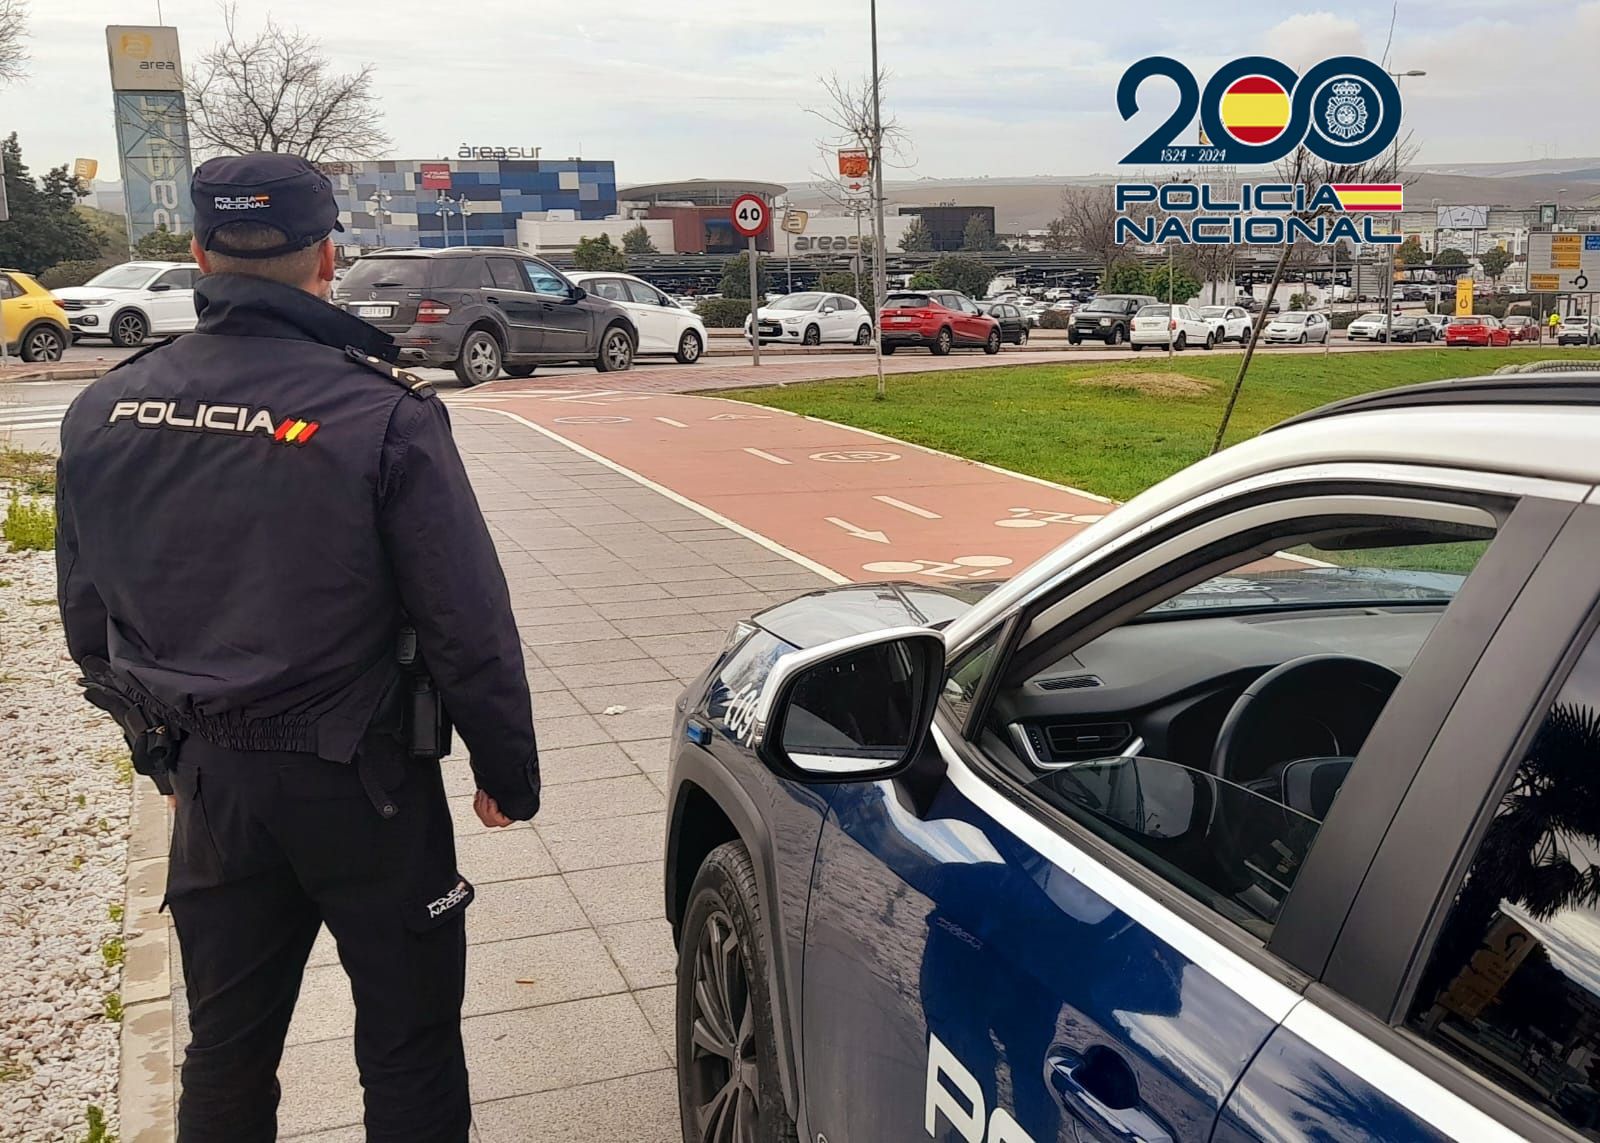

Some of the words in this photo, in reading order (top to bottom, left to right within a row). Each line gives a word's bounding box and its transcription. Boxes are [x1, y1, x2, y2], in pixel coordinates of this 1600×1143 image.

[140, 61, 176, 70] area
[215, 201, 271, 210] NACIONAL
[738, 207, 760, 221] 40
[108, 401, 275, 435] POLICIA
